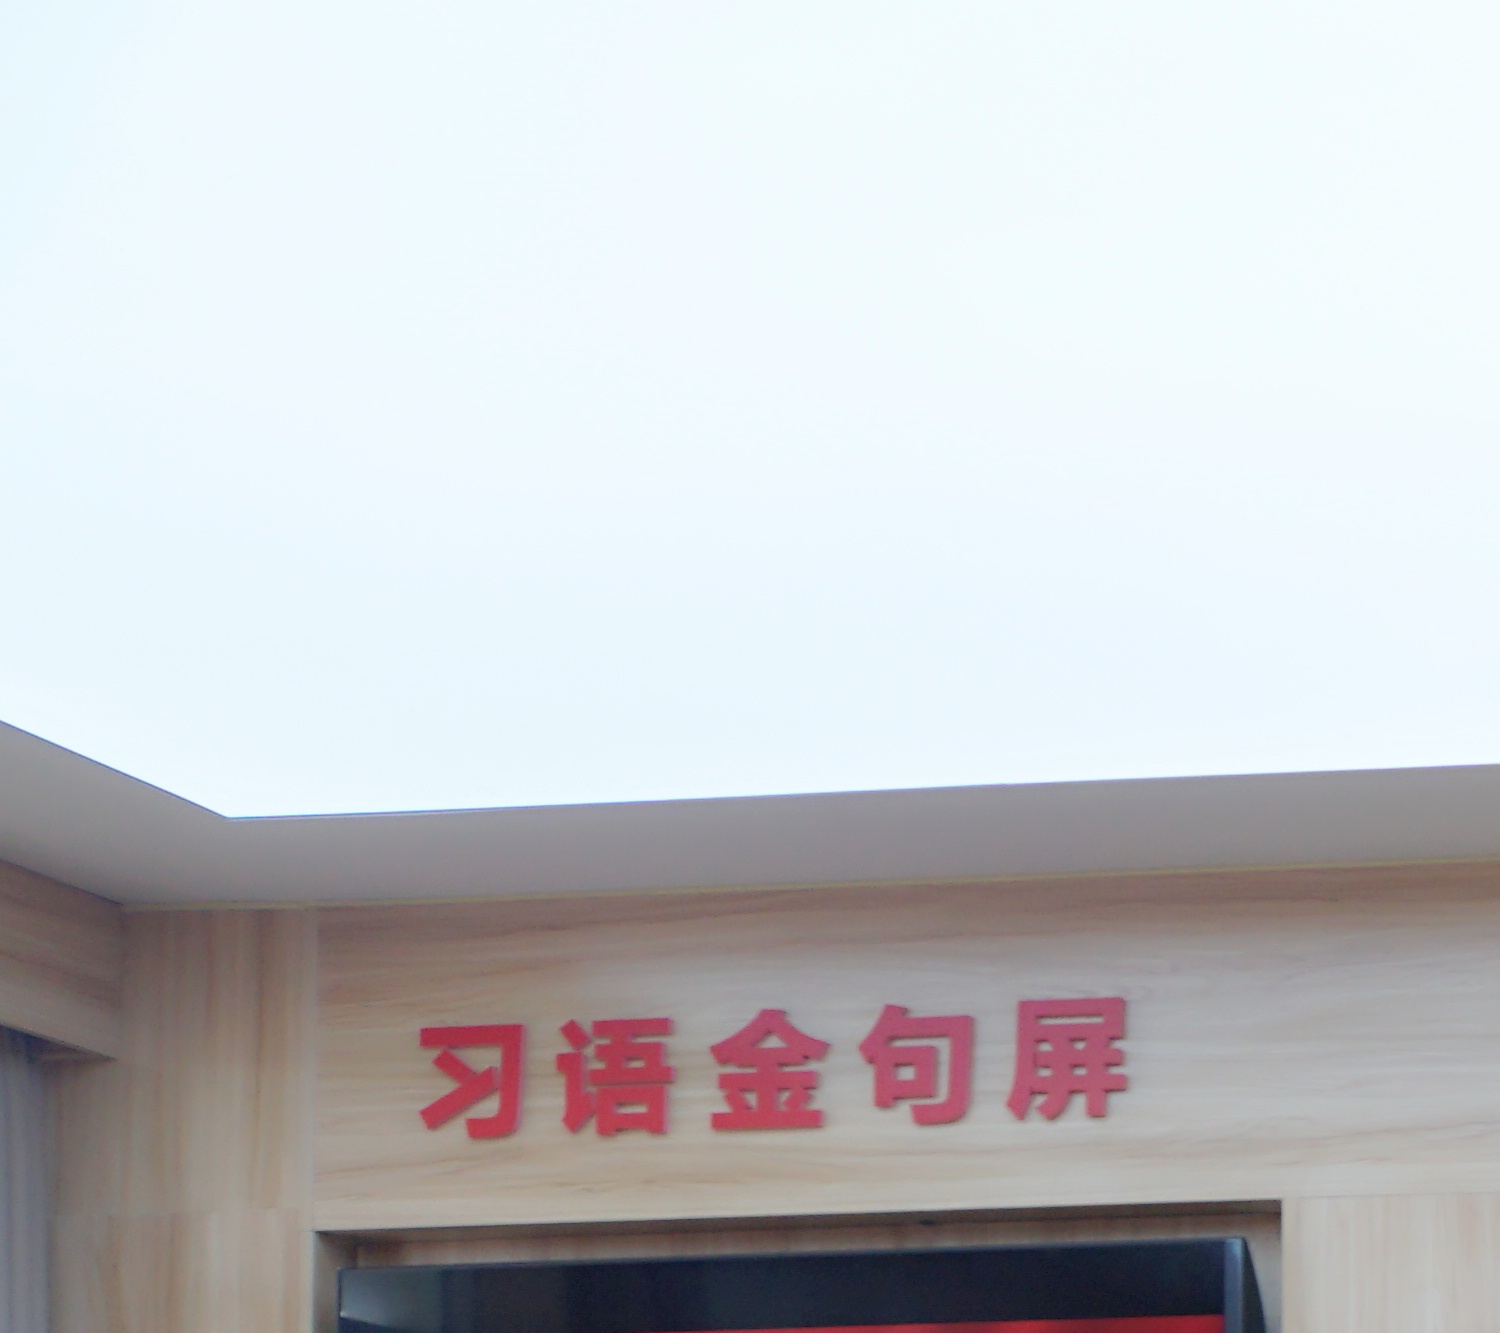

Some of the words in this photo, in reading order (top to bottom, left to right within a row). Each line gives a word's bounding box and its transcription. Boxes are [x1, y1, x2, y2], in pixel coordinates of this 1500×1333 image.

[418, 997, 1130, 1140] 习语金句屏
